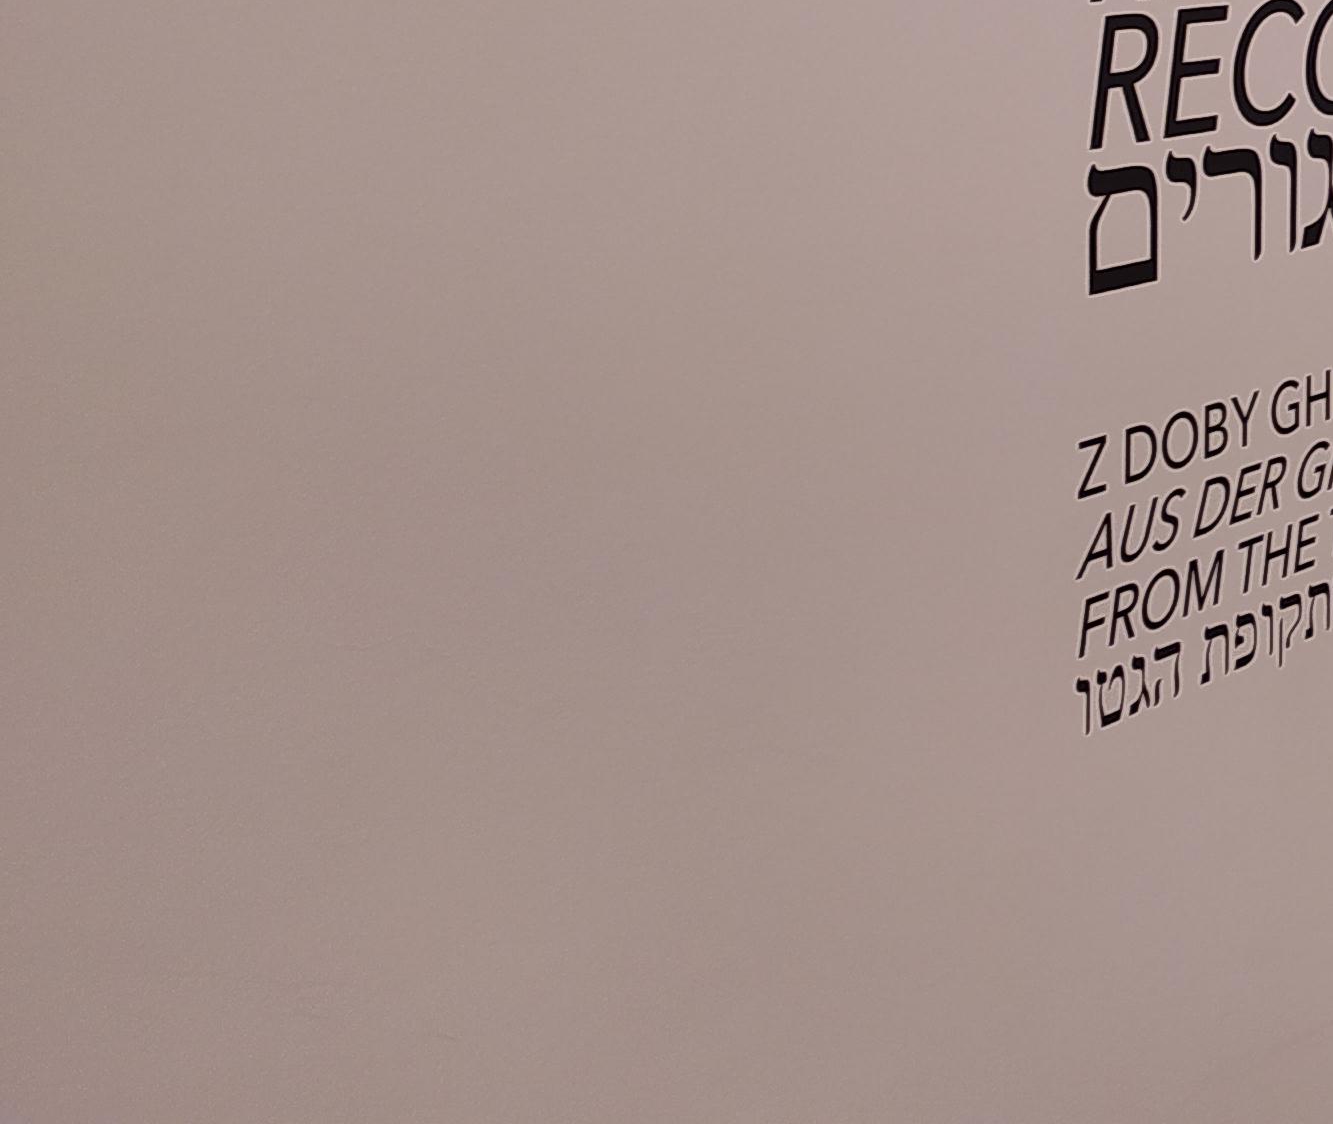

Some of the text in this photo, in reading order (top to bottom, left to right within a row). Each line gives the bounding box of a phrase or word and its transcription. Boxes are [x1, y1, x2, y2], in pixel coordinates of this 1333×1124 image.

[1077, 434, 1107, 500] Z
[1124, 390, 1260, 485] DOBY
[1075, 488, 1187, 581] AUS
[1193, 456, 1288, 539] DER
[1078, 549, 1225, 659] FROM
[1237, 513, 1320, 594] THE
[1075, 640, 1181, 735] הגטו
